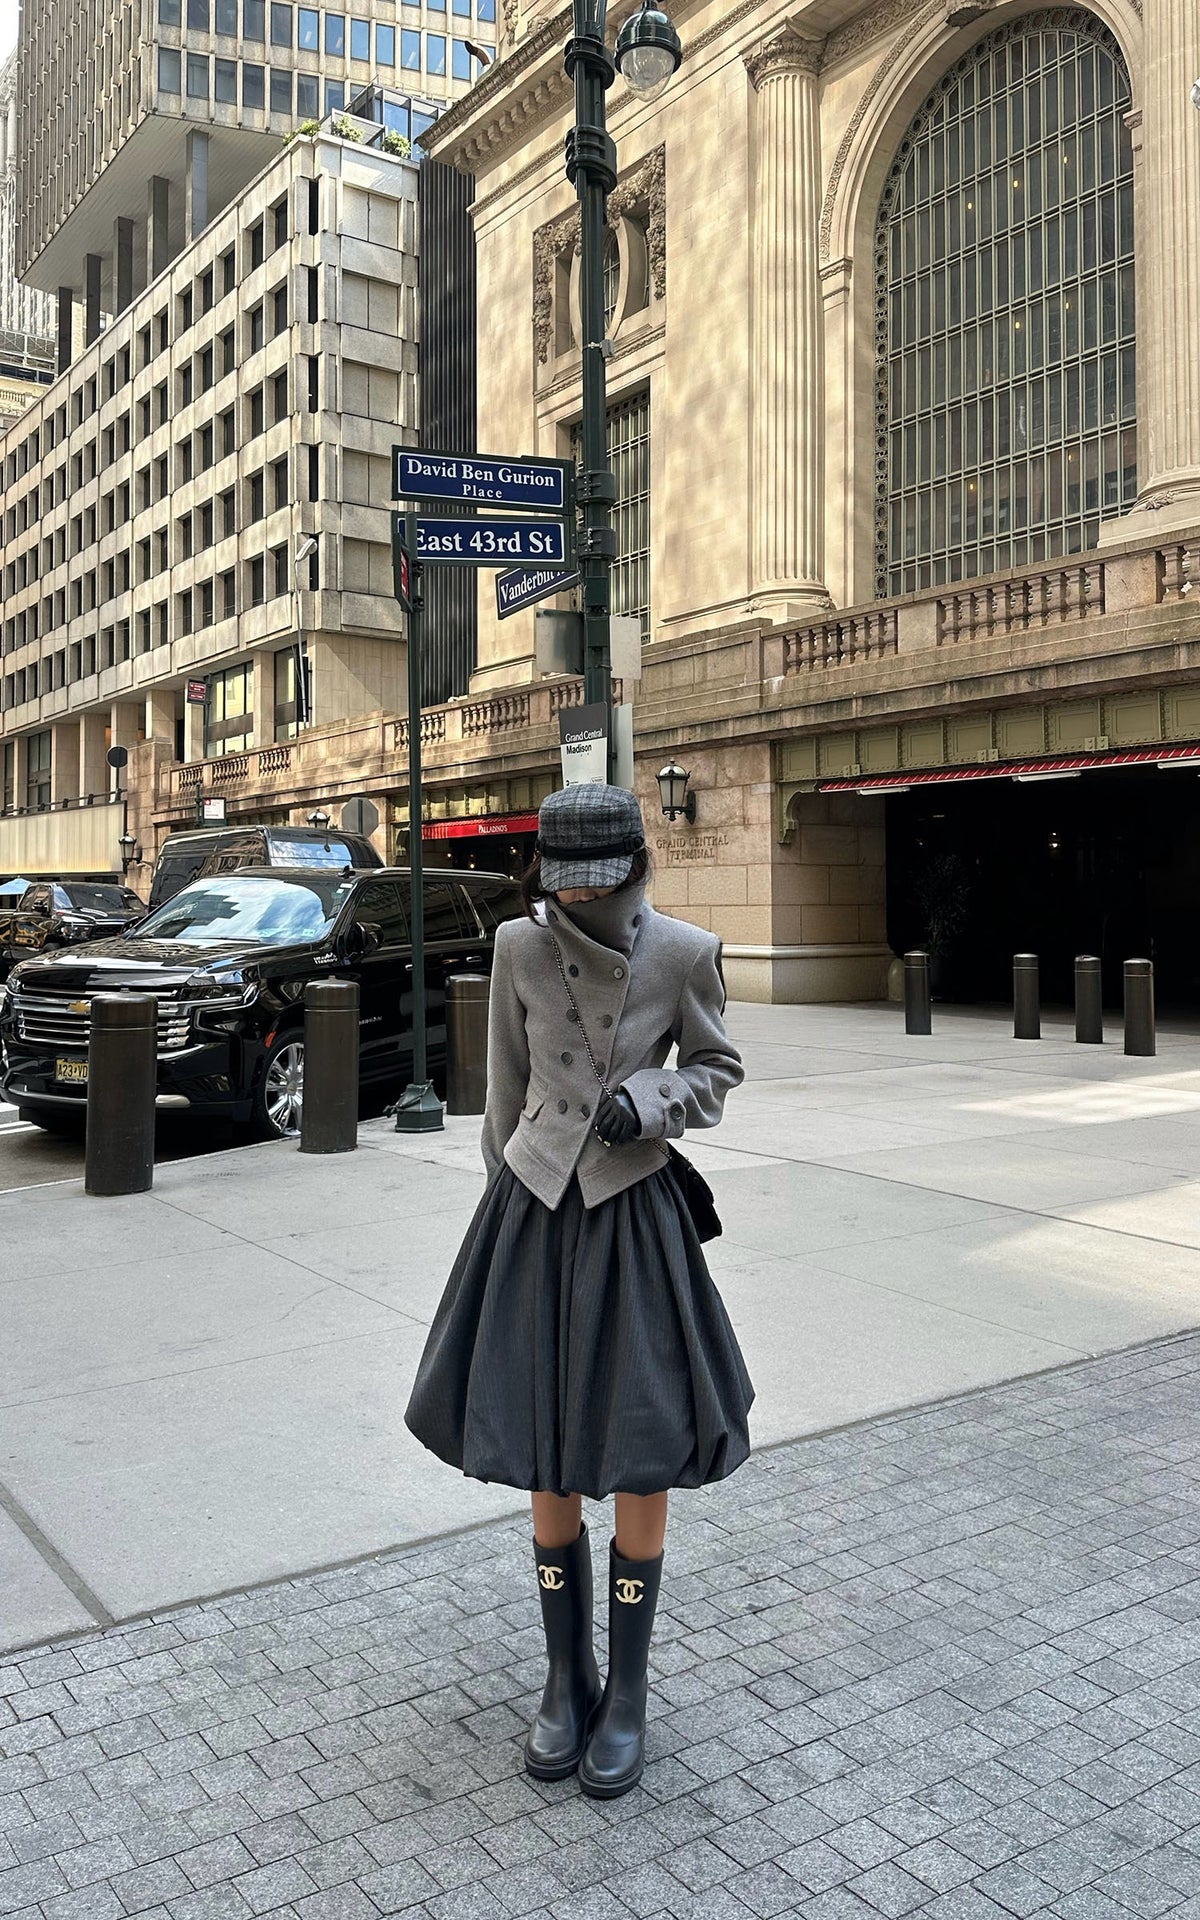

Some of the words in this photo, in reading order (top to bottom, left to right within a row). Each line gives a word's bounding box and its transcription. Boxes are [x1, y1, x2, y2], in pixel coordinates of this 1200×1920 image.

[407, 458, 457, 479] David
[461, 464, 494, 482] Ben
[498, 467, 555, 487] Gurion
[462, 484, 503, 499] Place
[416, 528, 463, 551] East
[469, 530, 521, 553] 43rd
[528, 531, 554, 554] St
[565, 731, 584, 743] Grand
[583, 727, 603, 740] Central
[566, 744, 592, 755] Madison
[656, 838, 686, 849] GRAND
[688, 835, 730, 847] CENTRAL
